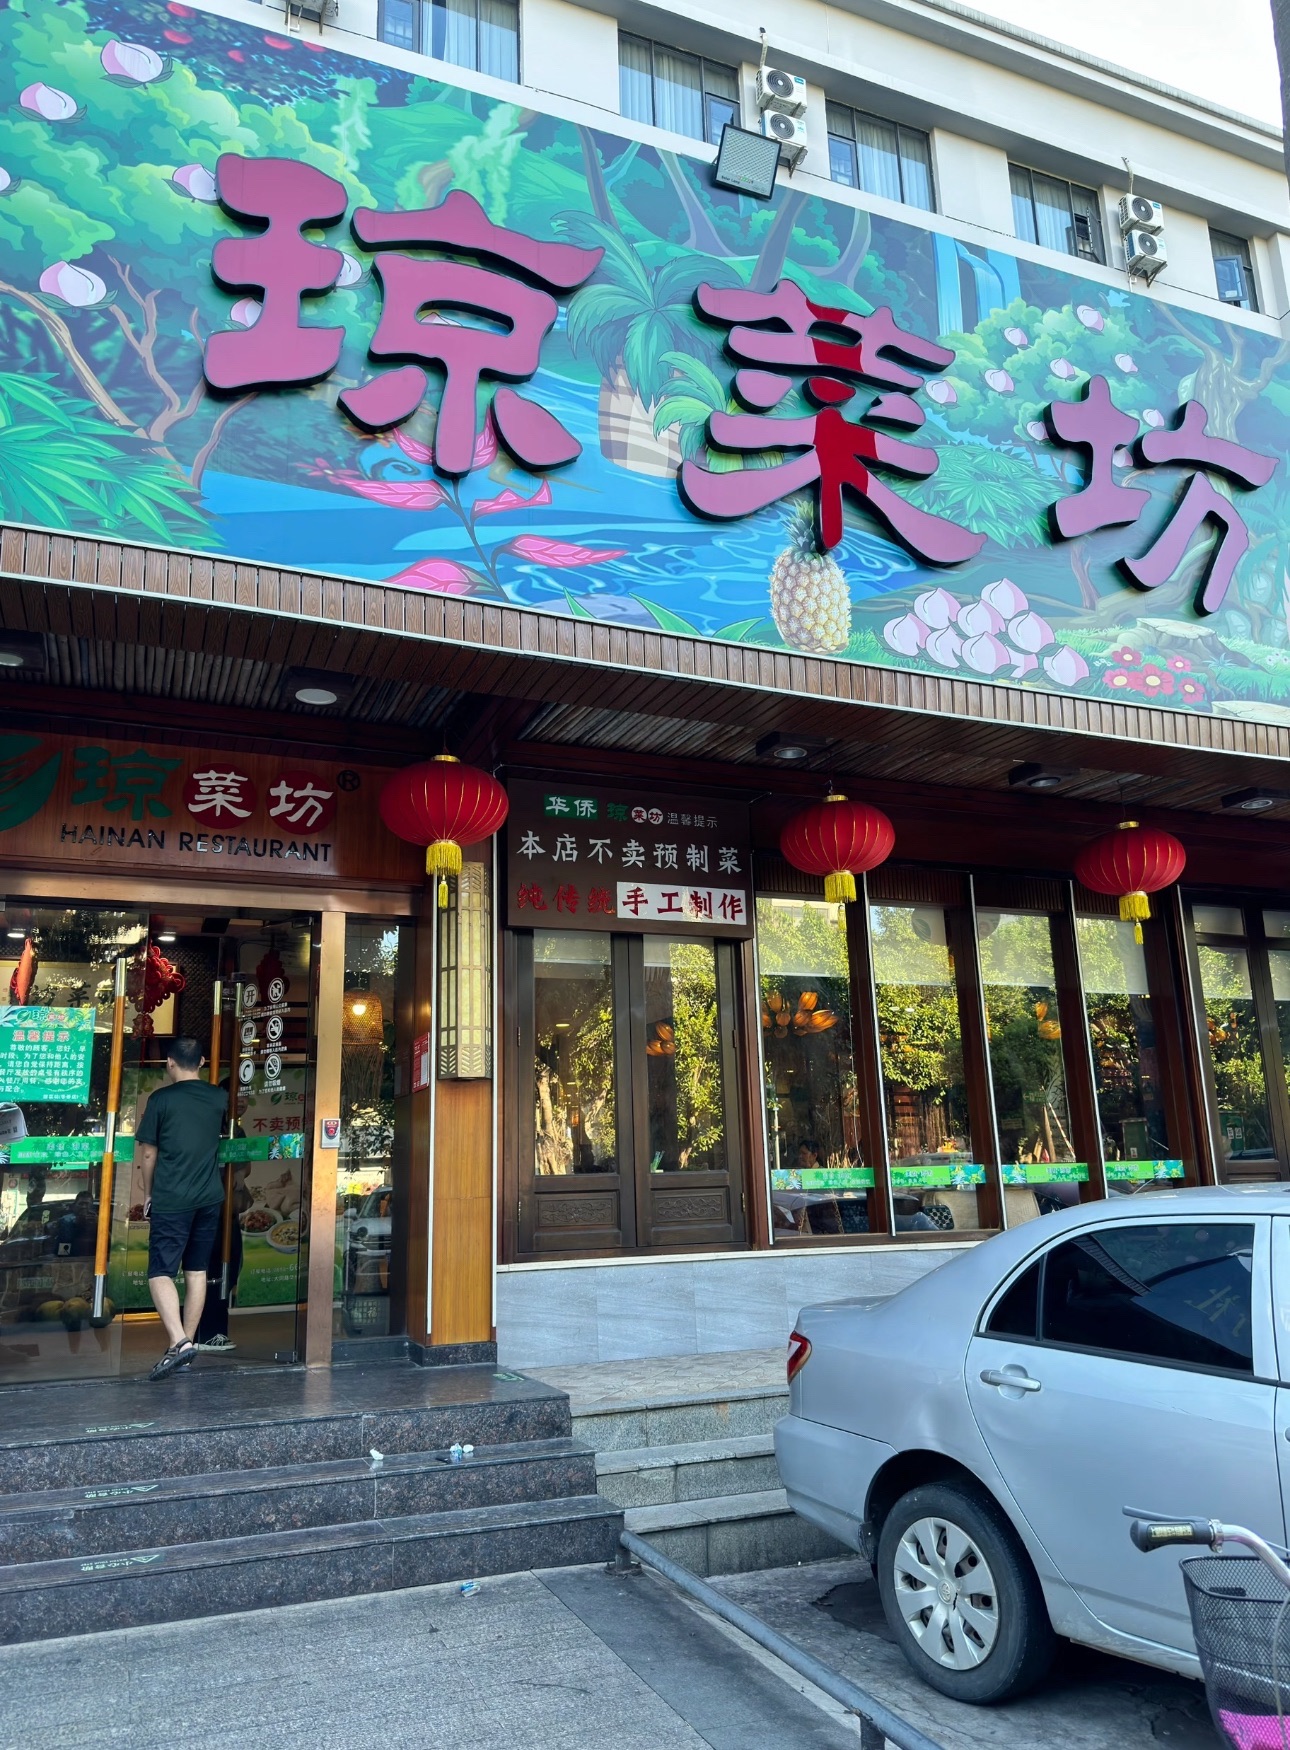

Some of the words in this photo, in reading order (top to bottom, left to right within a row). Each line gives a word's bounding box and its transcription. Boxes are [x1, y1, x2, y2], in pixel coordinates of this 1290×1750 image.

[203, 152, 1280, 615] 琼菜坊
[71, 746, 334, 827] 琼菜坊
[546, 796, 598, 818] 华侨
[607, 802, 662, 824] 琼菜坊
[667, 812, 718, 829] 温馨提示
[61, 823, 165, 849] HAINAN
[179, 831, 332, 862] RESTAURANT
[516, 830, 742, 874] 本店不卖预制菜
[12, 1030, 70, 1042] 温馨提示
